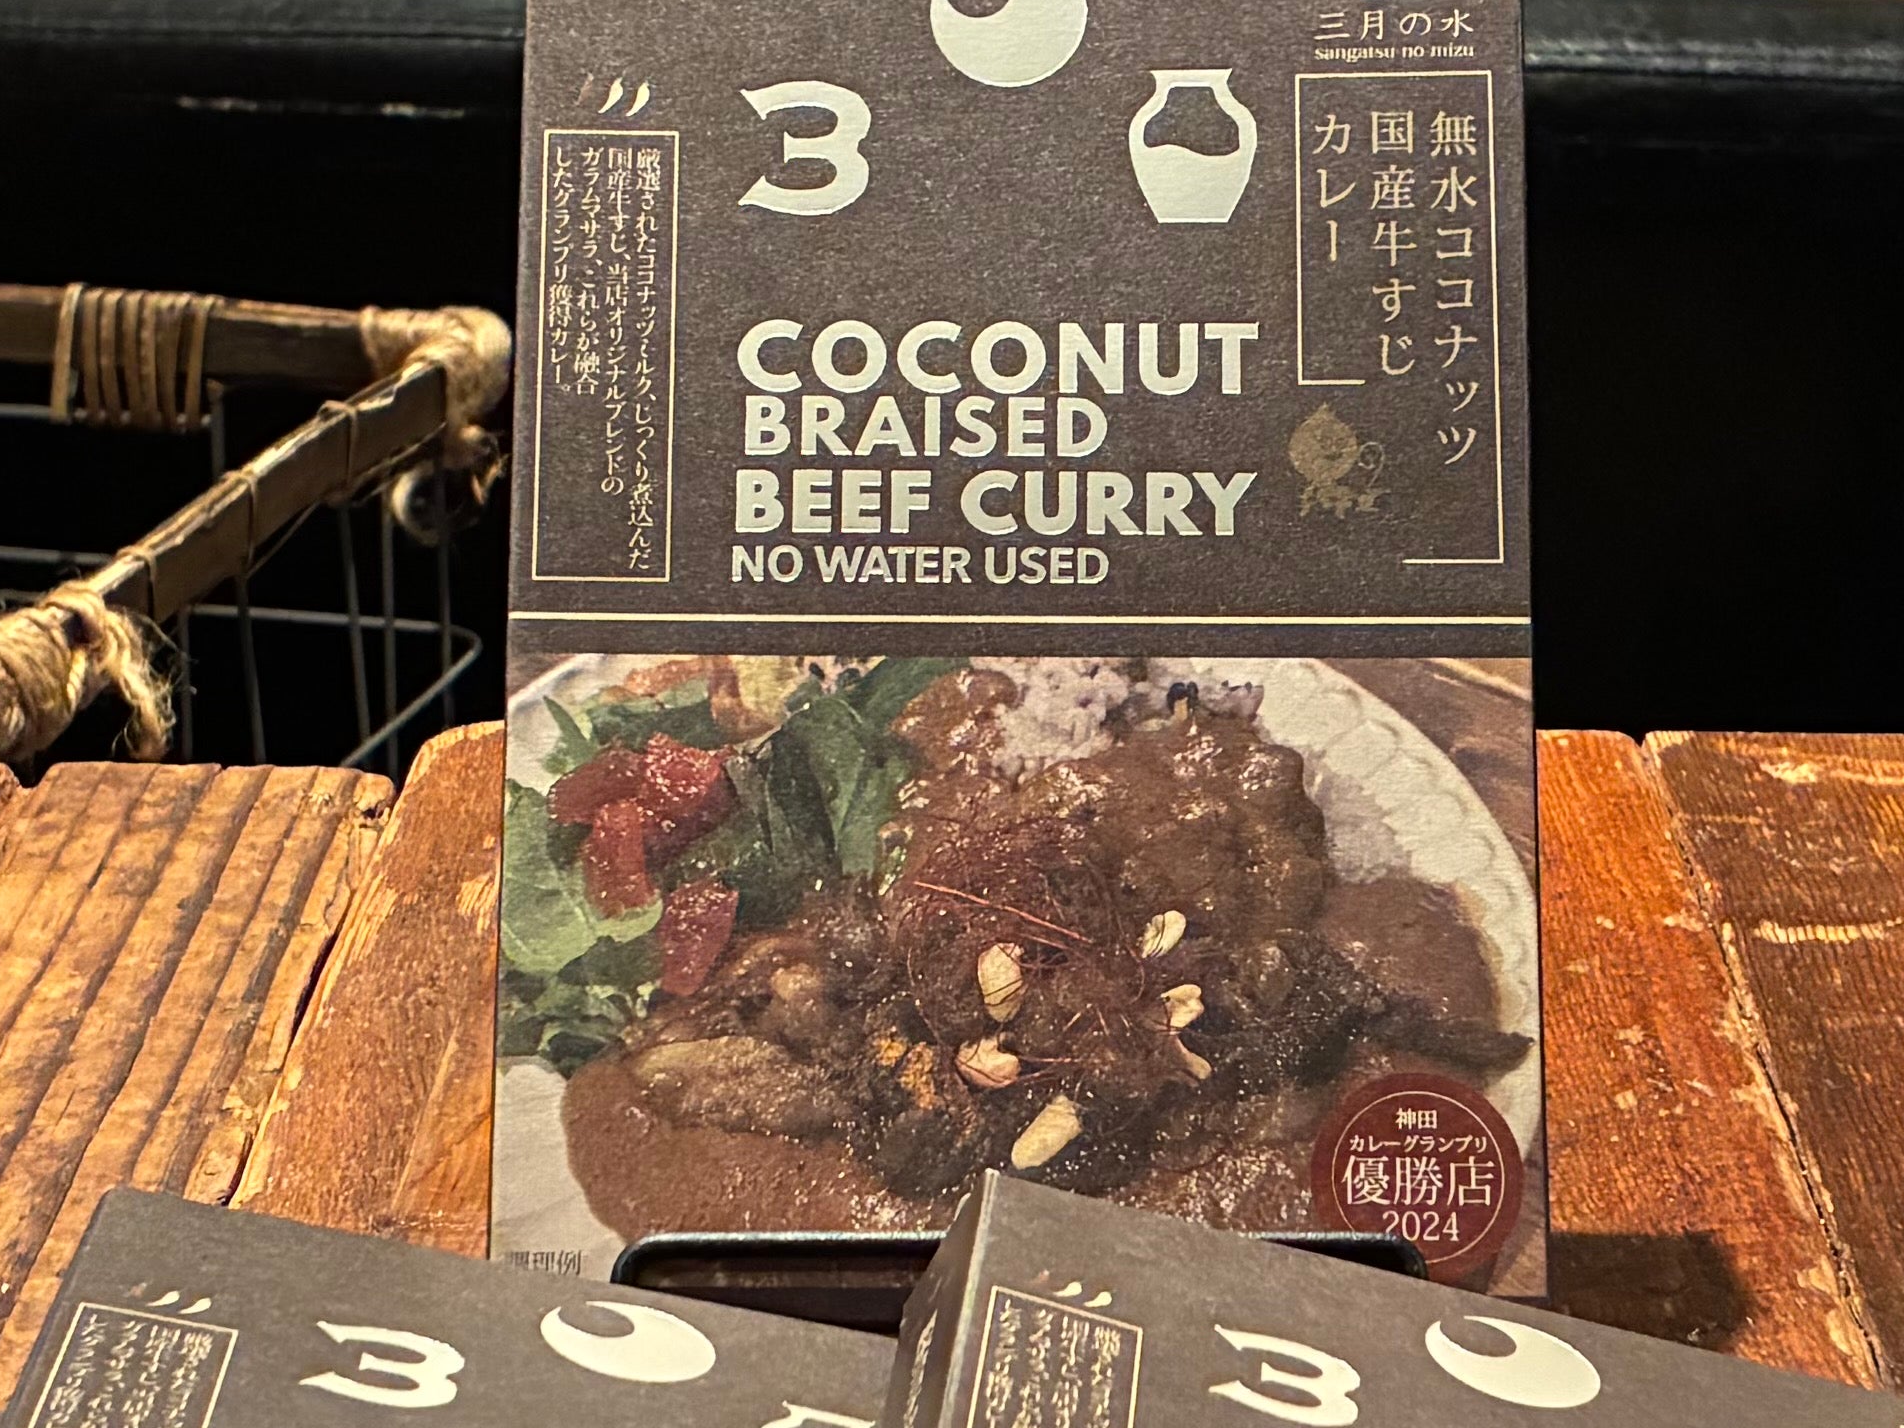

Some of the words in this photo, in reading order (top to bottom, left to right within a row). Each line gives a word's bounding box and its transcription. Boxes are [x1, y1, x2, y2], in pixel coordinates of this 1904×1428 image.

[1313, 9, 1474, 41] 三月の水
[1314, 44, 1395, 62] sangatsu
[1402, 45, 1425, 58] no
[1430, 42, 1475, 58] mizu
[1312, 113, 1356, 262] カレー
[1370, 110, 1417, 376] 国産牛すじ
[1429, 110, 1478, 465] 無水ココナッツ
[737, 319, 1259, 395] COCONUT
[745, 395, 1107, 457] BRAISED
[736, 469, 931, 533] BEEF
[961, 470, 1257, 535] CURRY
[732, 545, 803, 582] NO
[814, 546, 971, 583] WATER
[985, 547, 1109, 584] USED
[1349, 1134, 1487, 1153] カレーグランプリ
[1396, 1108, 1438, 1129] 神田
[1342, 1155, 1495, 1206] 優勝店
[1382, 1211, 1459, 1241] 2024
